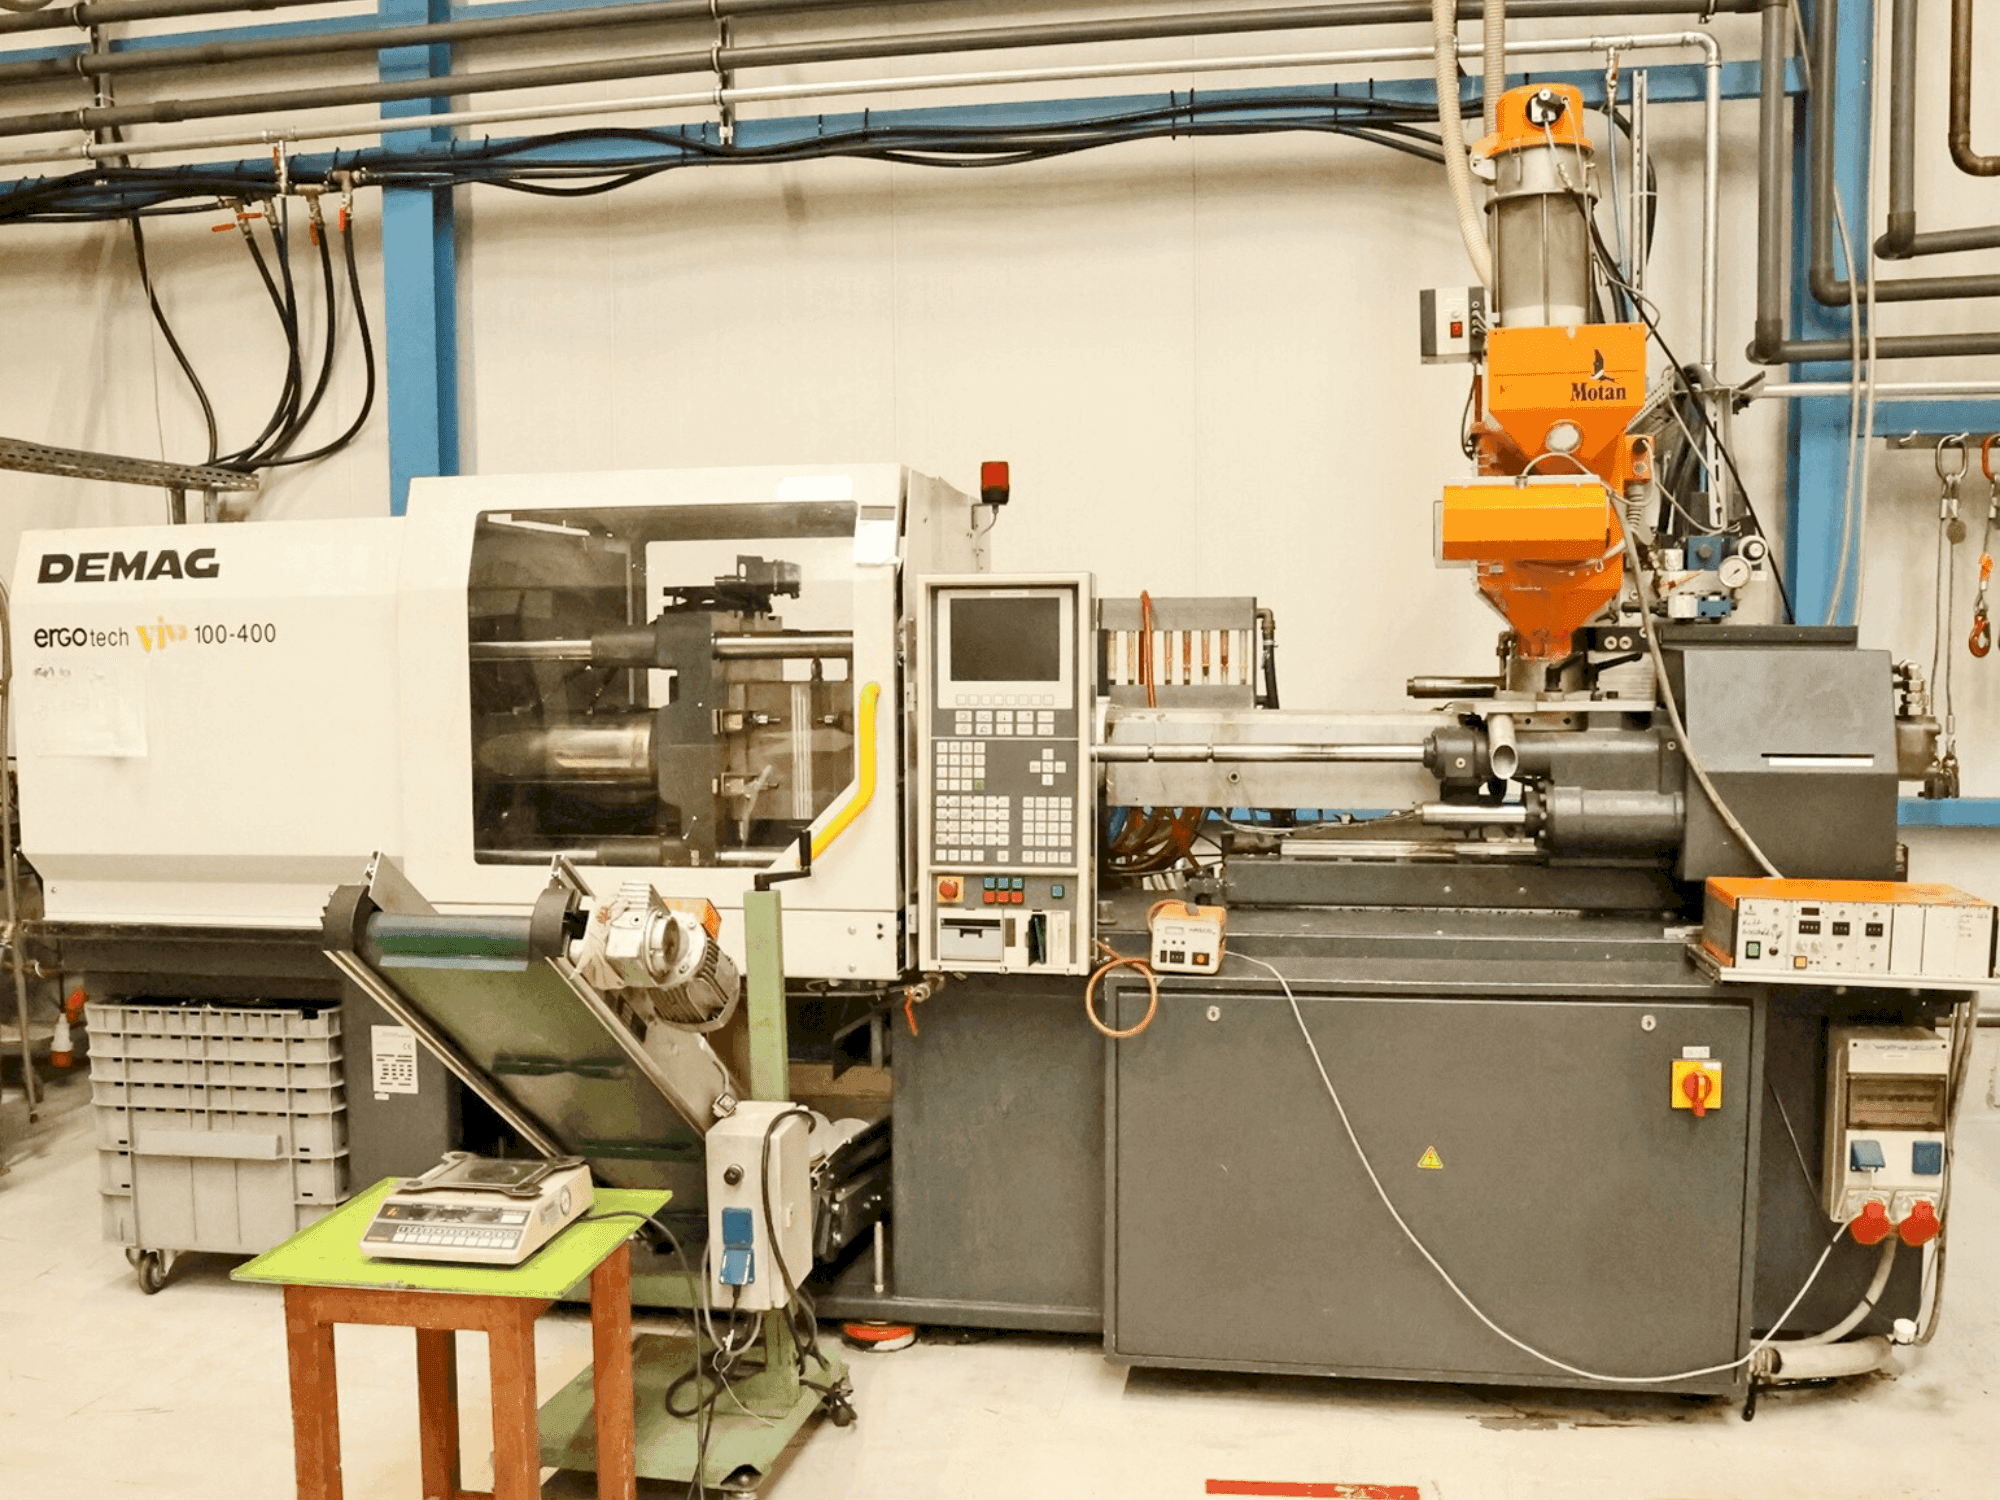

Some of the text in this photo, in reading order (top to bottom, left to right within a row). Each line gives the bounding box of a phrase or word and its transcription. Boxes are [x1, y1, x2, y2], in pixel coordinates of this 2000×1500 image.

[1570, 382, 1627, 402] Motan
[37, 548, 220, 584] DEMAG
[194, 623, 276, 644] 100-400
